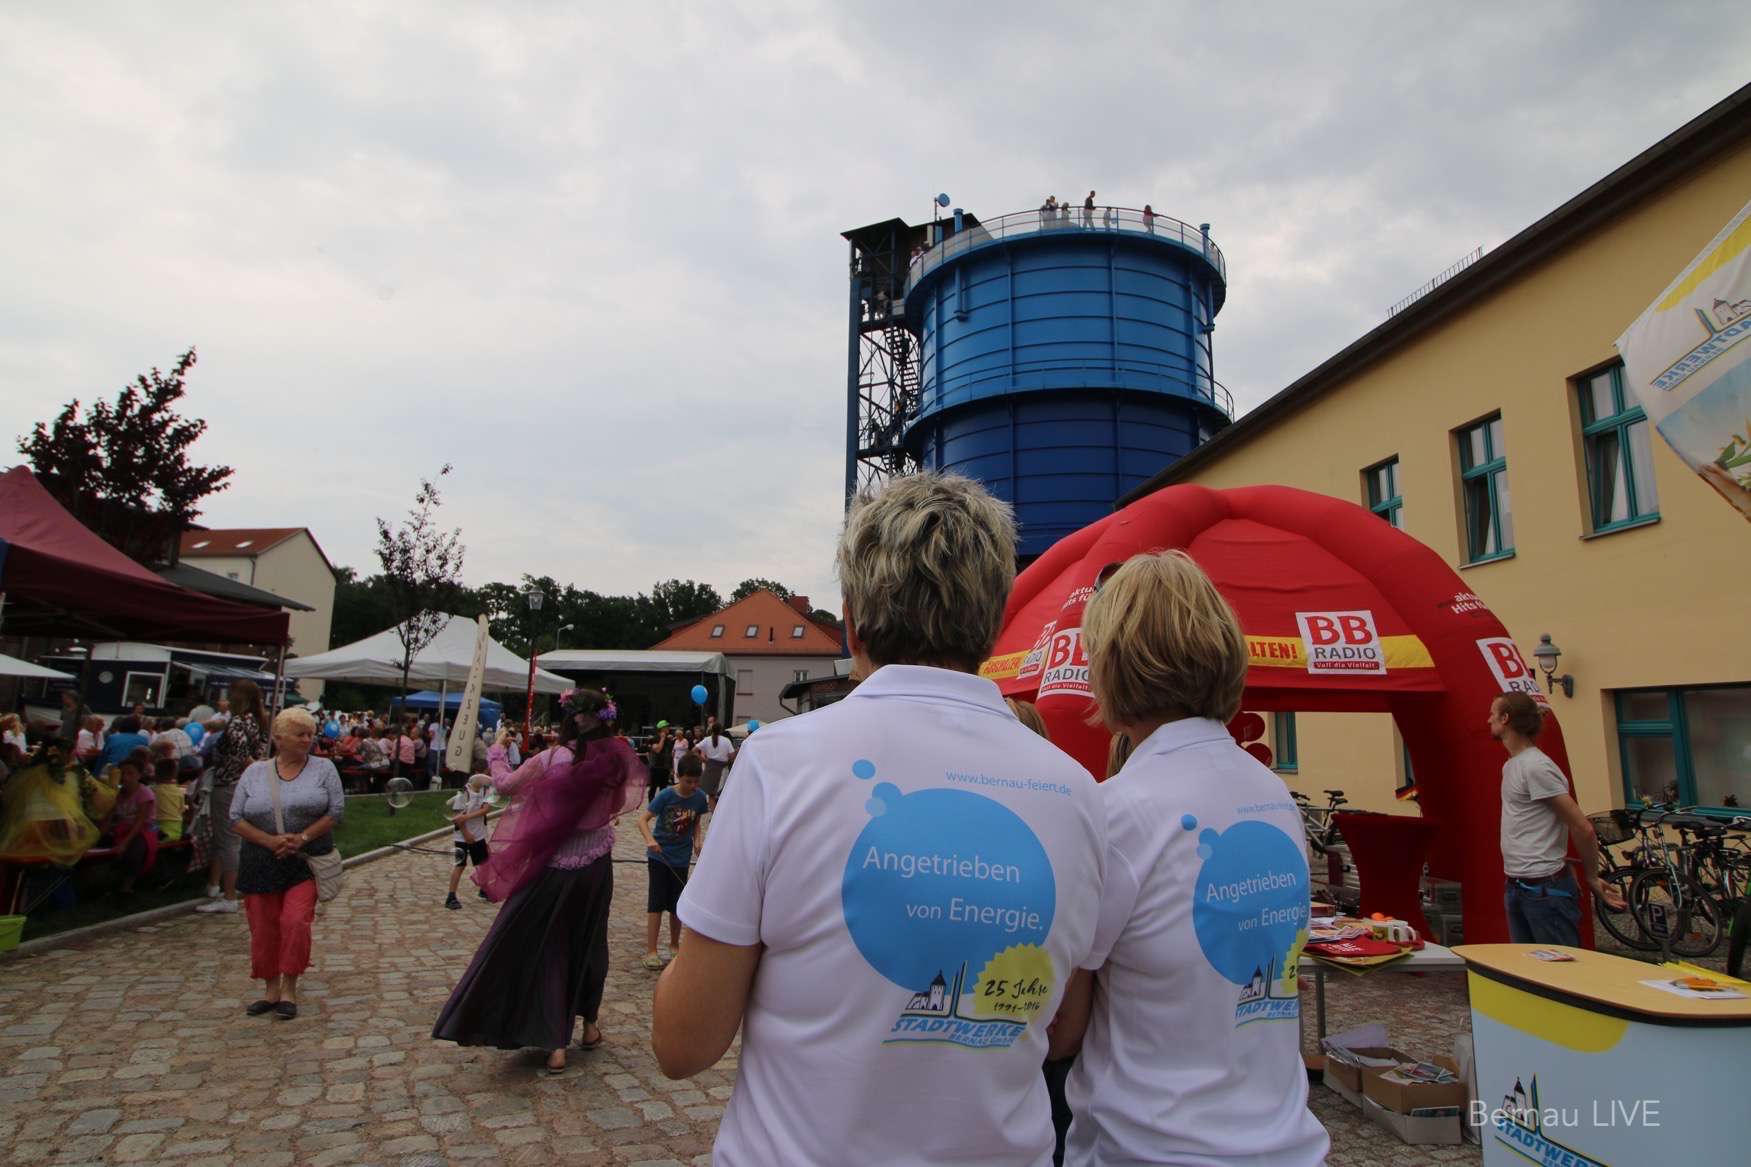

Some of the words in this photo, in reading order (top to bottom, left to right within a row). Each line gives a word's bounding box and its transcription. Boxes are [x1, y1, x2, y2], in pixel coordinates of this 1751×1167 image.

[1304, 615, 1373, 646] BB
[1248, 641, 1298, 659] LTEN!
[1314, 647, 1376, 660] RADIO
[1487, 643, 1534, 679] B
[945, 771, 1072, 796] www.bernau-feiert.de
[863, 846, 1020, 883] Angetrieben
[1206, 870, 1297, 903] Angetrieben
[906, 903, 942, 919] von
[950, 897, 1043, 932] Energie.
[1238, 917, 1258, 931] von
[984, 979, 1008, 996] 25
[891, 1018, 1025, 1037] STADTWERKE
[1497, 1118, 1600, 1167] STADTWER
